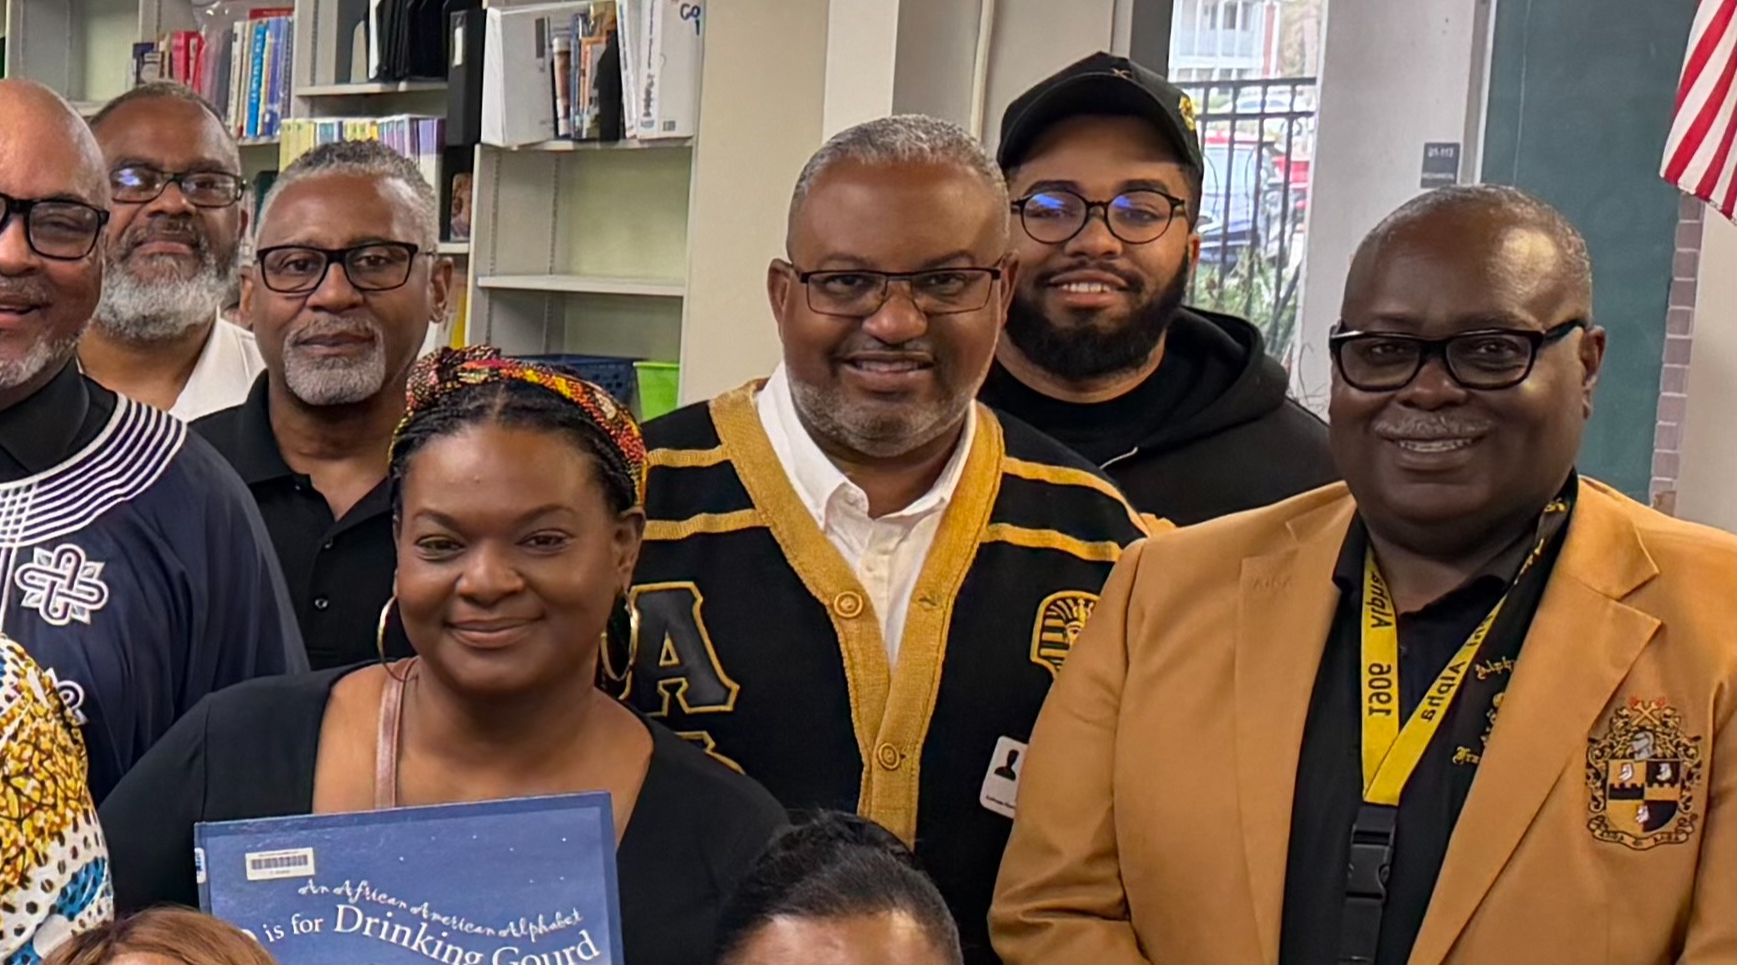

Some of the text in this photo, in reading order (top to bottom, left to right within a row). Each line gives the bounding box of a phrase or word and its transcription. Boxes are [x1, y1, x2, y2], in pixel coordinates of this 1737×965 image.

[263, 920, 285, 943] is
[291, 913, 325, 935] for
[332, 879, 408, 910] African
[409, 902, 496, 937] American
[498, 907, 585, 943] Alphabet
